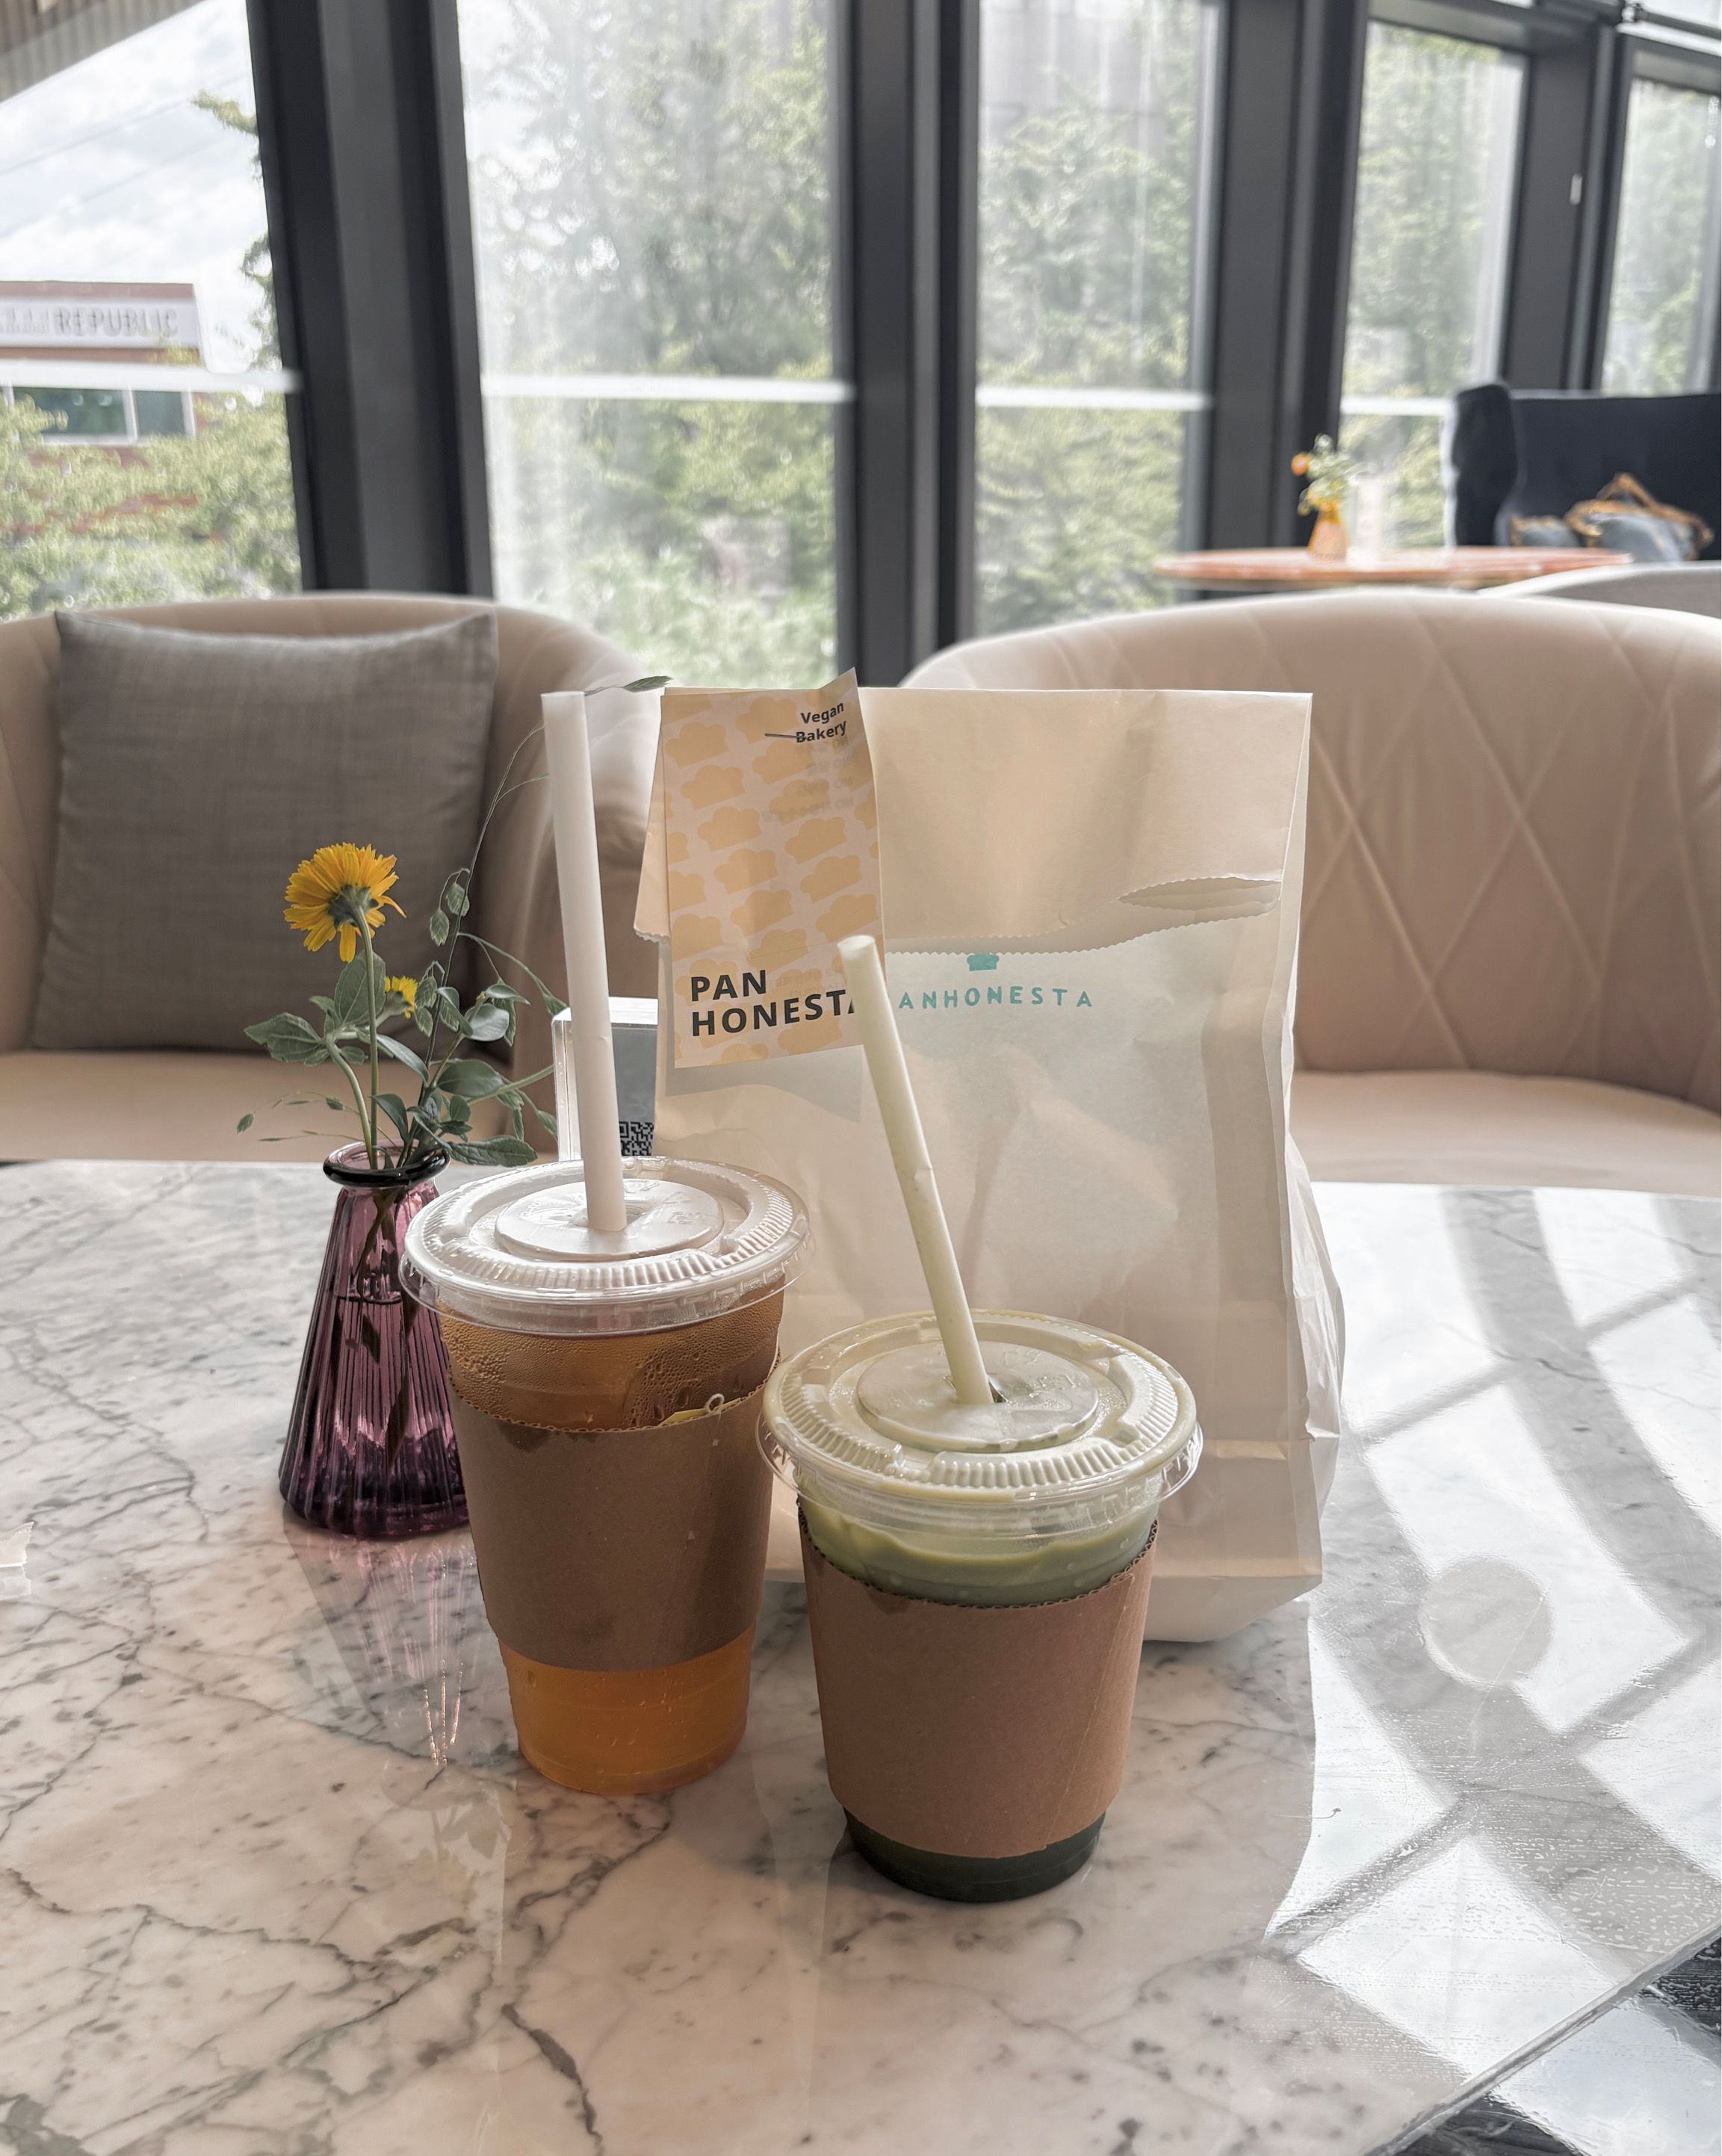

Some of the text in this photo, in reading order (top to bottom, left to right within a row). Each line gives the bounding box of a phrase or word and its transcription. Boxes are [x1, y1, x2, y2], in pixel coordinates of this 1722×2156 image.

[53, 306, 179, 337] REPUBLIC
[800, 702, 844, 724] Vegan
[796, 721, 846, 743] Bakery
[691, 970, 766, 1002] PAN
[898, 986, 1092, 1009] ANHONESTA
